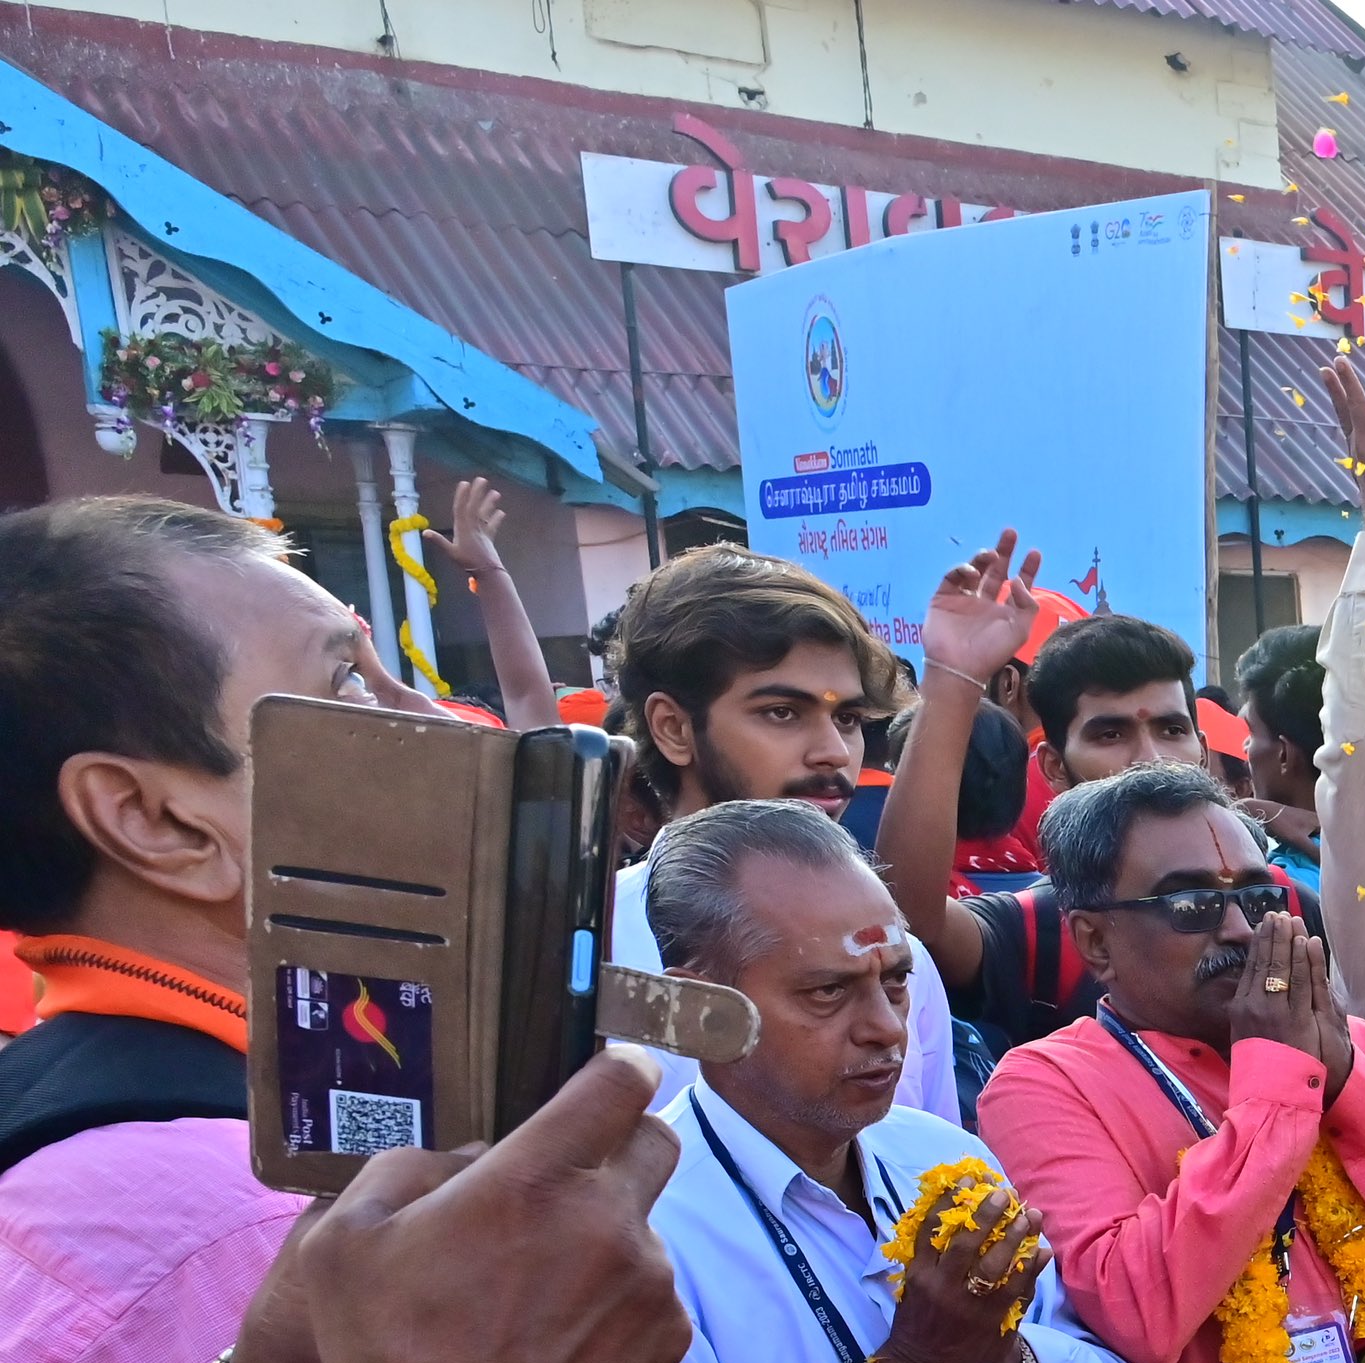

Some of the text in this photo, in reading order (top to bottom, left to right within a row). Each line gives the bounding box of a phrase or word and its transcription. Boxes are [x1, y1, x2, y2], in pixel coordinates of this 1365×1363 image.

[830, 440, 879, 469] Somnath
[839, 471, 869, 509] தமிழ்
[871, 467, 921, 498] சங்கமம்
[830, 519, 859, 553] તમિલ
[861, 520, 888, 550] સંગમ
[893, 616, 923, 645] Bhar
[287, 1092, 302, 1151] Payments Ba
[302, 1118, 313, 1145] Post
[798, 1262, 815, 1288] IRCTC
